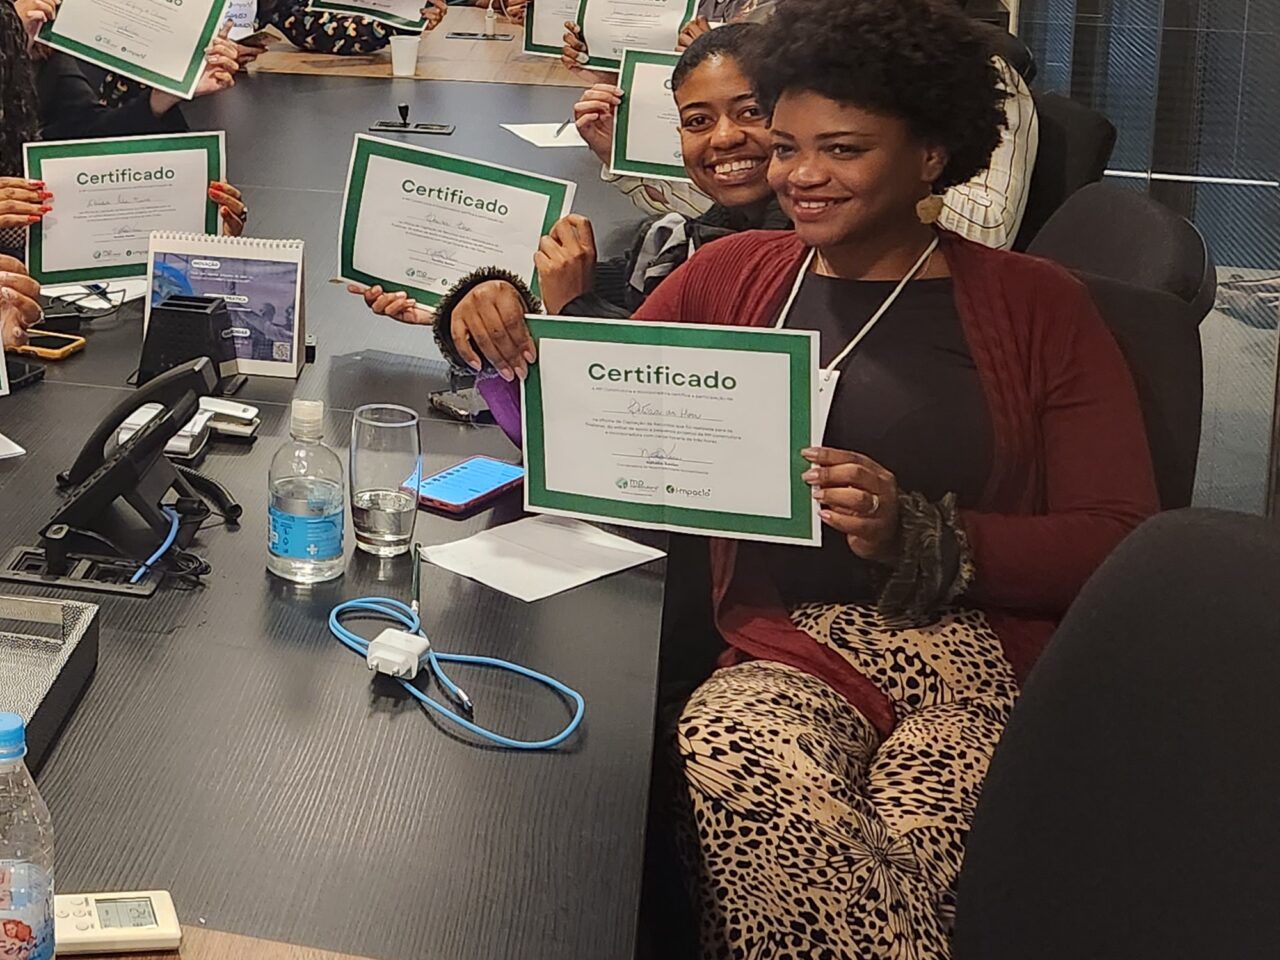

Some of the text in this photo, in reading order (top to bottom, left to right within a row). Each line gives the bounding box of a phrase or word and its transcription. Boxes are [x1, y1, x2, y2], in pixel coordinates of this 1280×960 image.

[77, 167, 175, 186] Certificado
[402, 179, 509, 216] Certificado
[588, 363, 737, 390] Certificado
